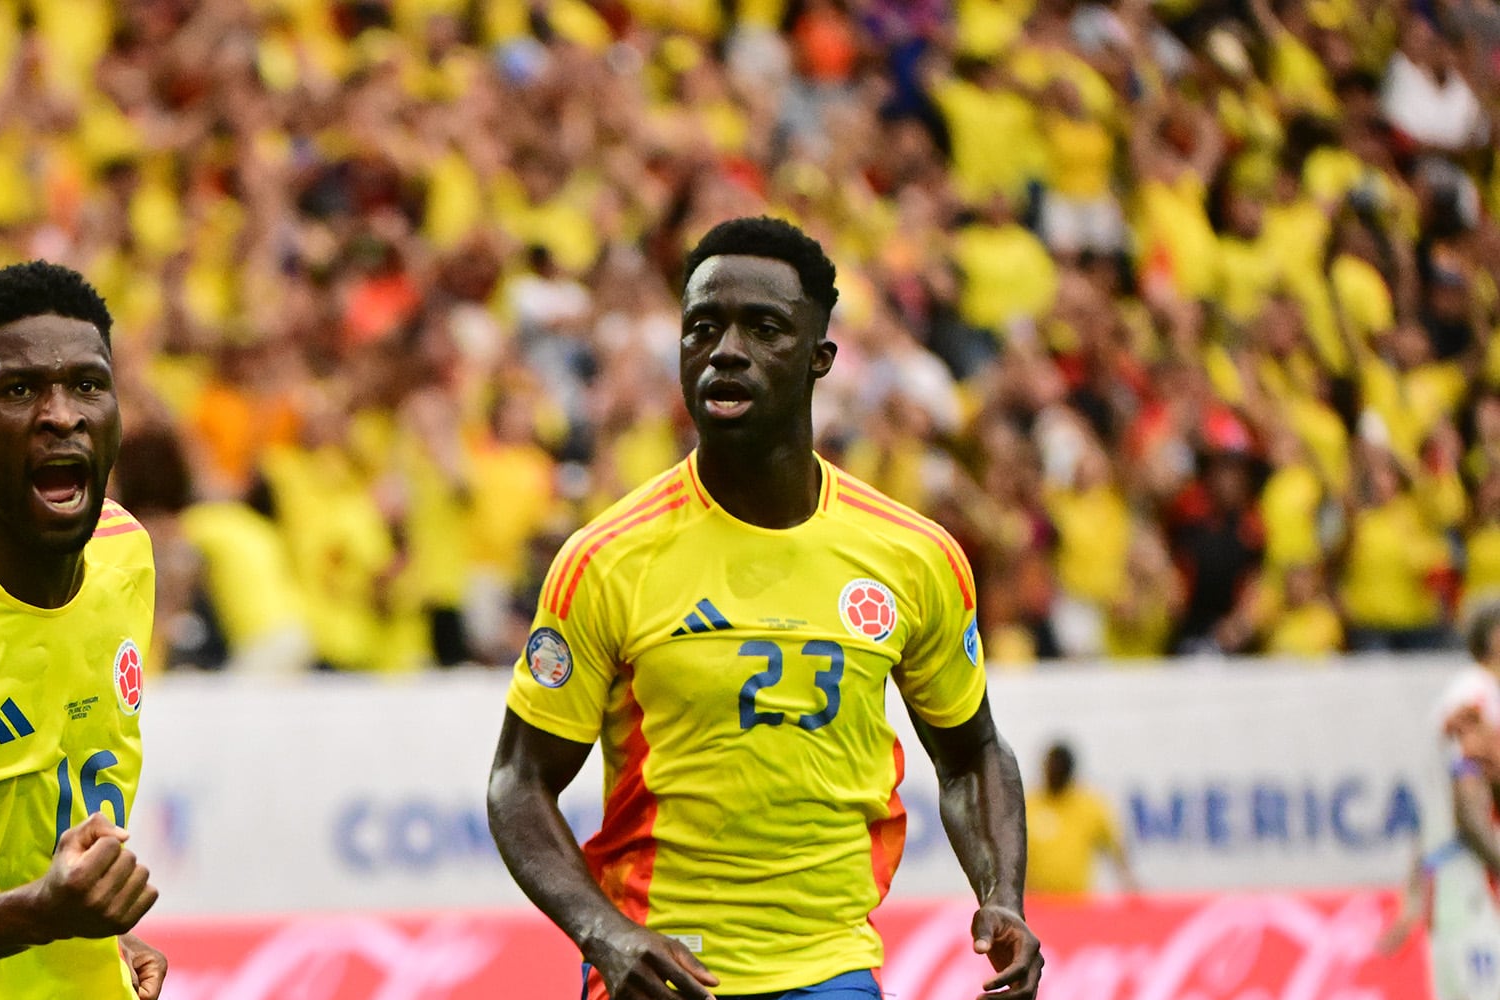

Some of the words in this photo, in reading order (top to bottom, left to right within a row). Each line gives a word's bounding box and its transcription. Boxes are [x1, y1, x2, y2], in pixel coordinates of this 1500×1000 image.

[738, 640, 845, 731] 23
[52, 750, 125, 855] 16
[1129, 780, 1421, 846] MERICA
